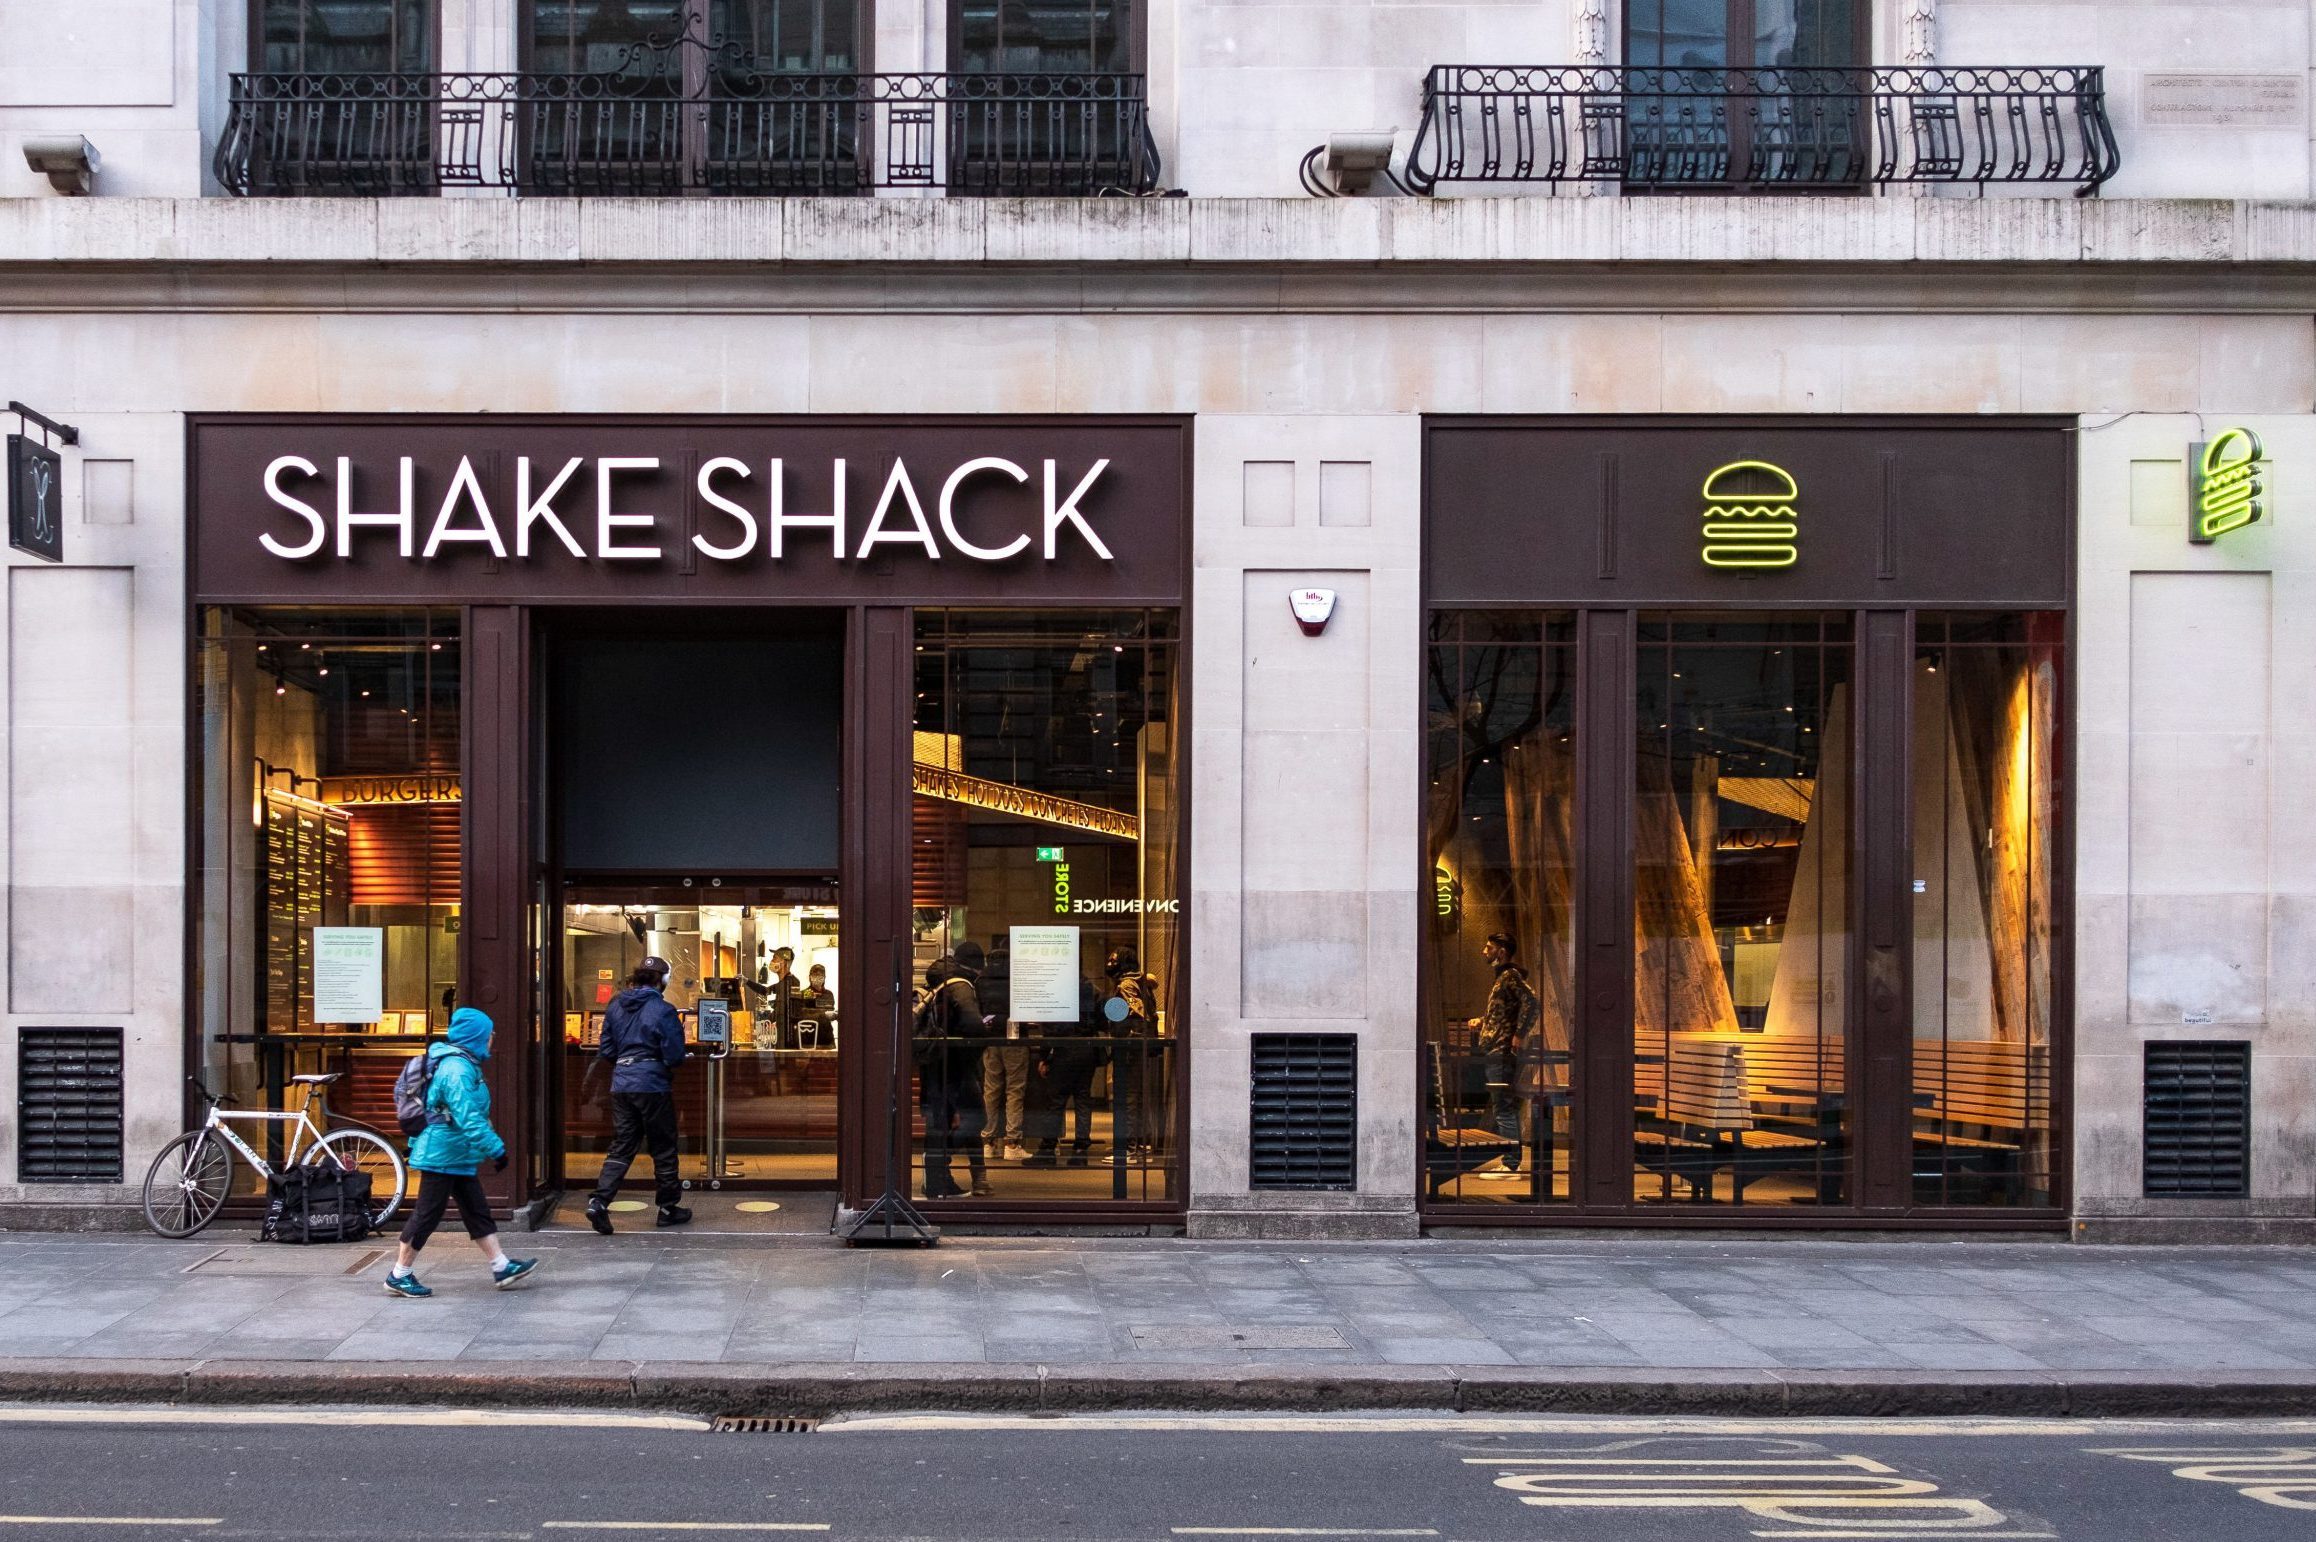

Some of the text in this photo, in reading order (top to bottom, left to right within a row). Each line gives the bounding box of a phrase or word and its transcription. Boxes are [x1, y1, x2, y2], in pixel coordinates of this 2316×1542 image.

[258, 456, 1114, 560] SHAKE SHACK
[806, 922, 827, 931] PICK
